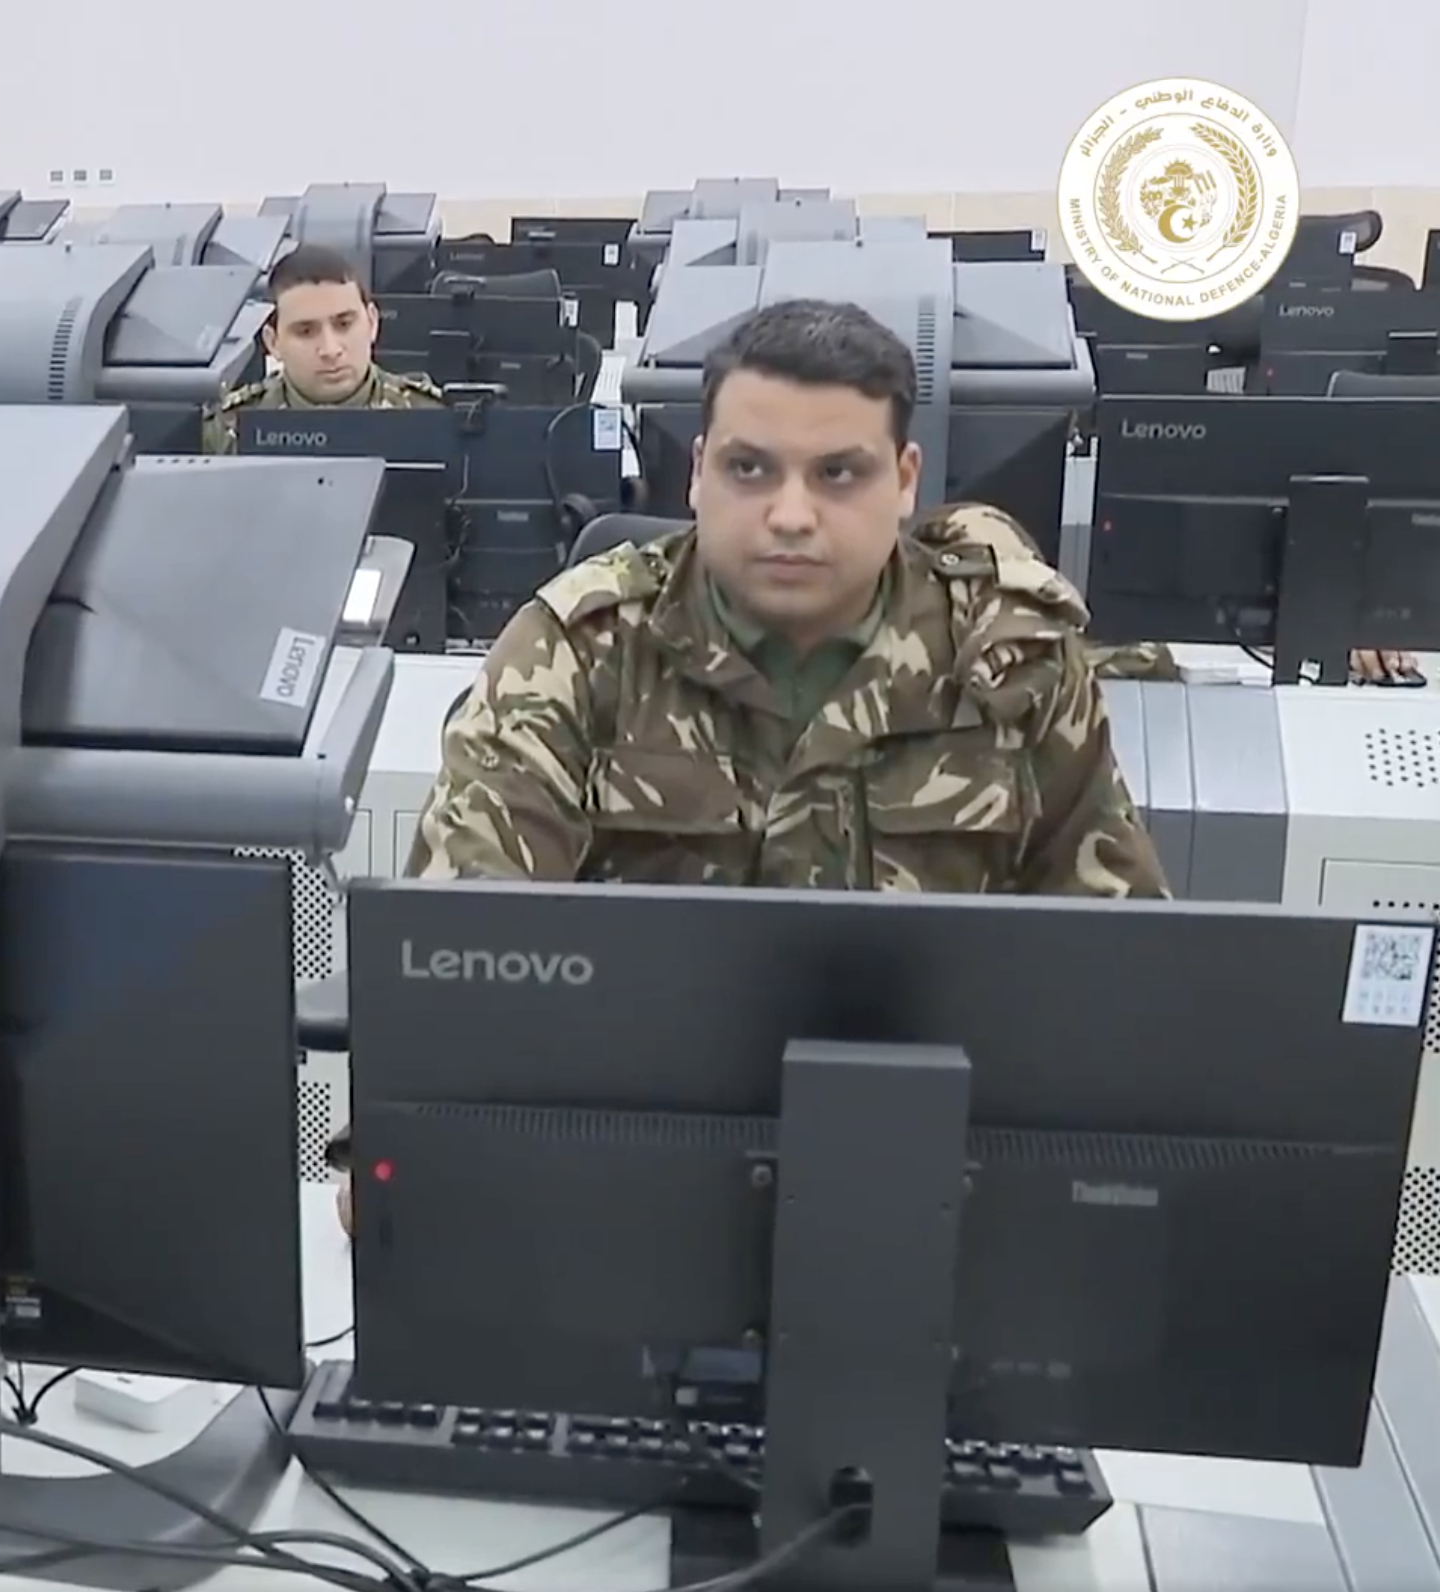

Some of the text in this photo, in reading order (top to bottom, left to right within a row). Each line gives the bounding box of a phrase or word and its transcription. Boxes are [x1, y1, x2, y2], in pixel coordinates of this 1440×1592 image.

[255, 427, 327, 447] Lenovo
[1121, 419, 1207, 439] Lenovo
[276, 636, 316, 698] Lenovo
[402, 939, 594, 985] Lenovo
